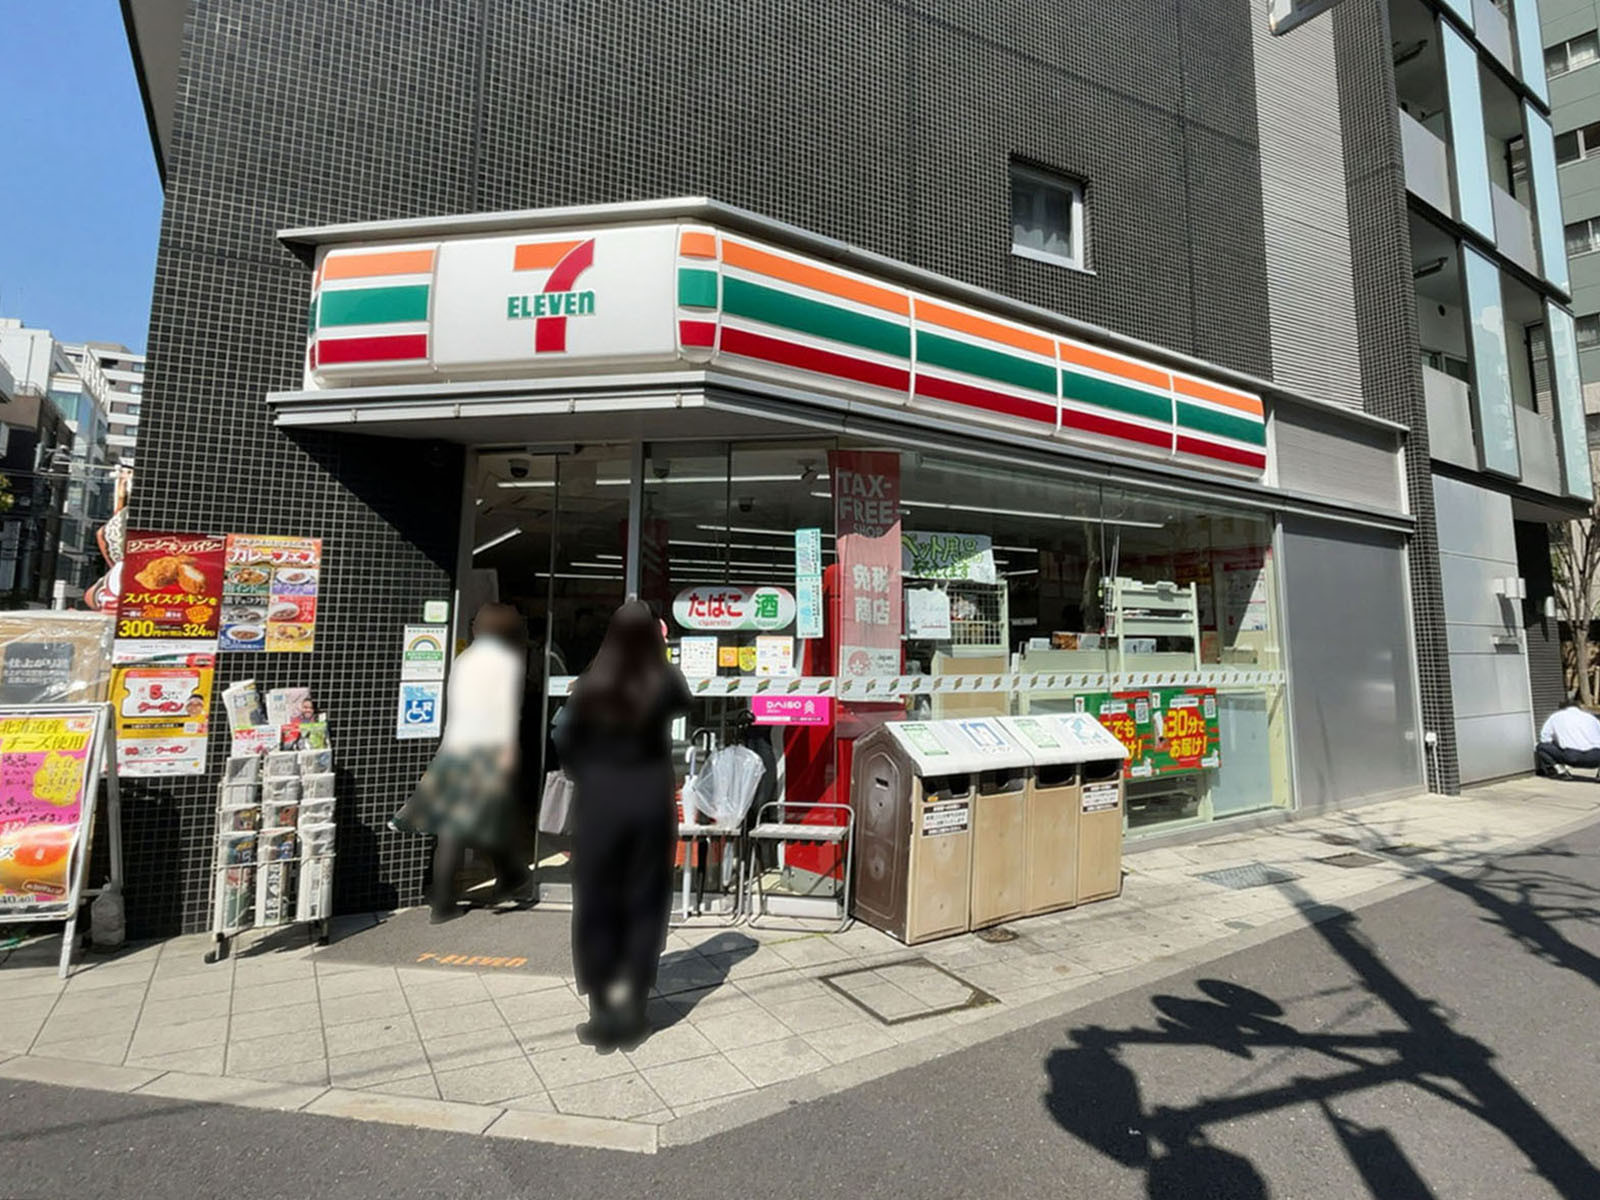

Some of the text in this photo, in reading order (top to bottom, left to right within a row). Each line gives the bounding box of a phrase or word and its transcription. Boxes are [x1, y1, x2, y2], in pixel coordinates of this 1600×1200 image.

[838, 472, 892, 499] TAX-
[839, 497, 894, 525] FREE
[688, 592, 743, 618] たばこ
[755, 593, 779, 618] 酒
[854, 596, 890, 625] 商店
